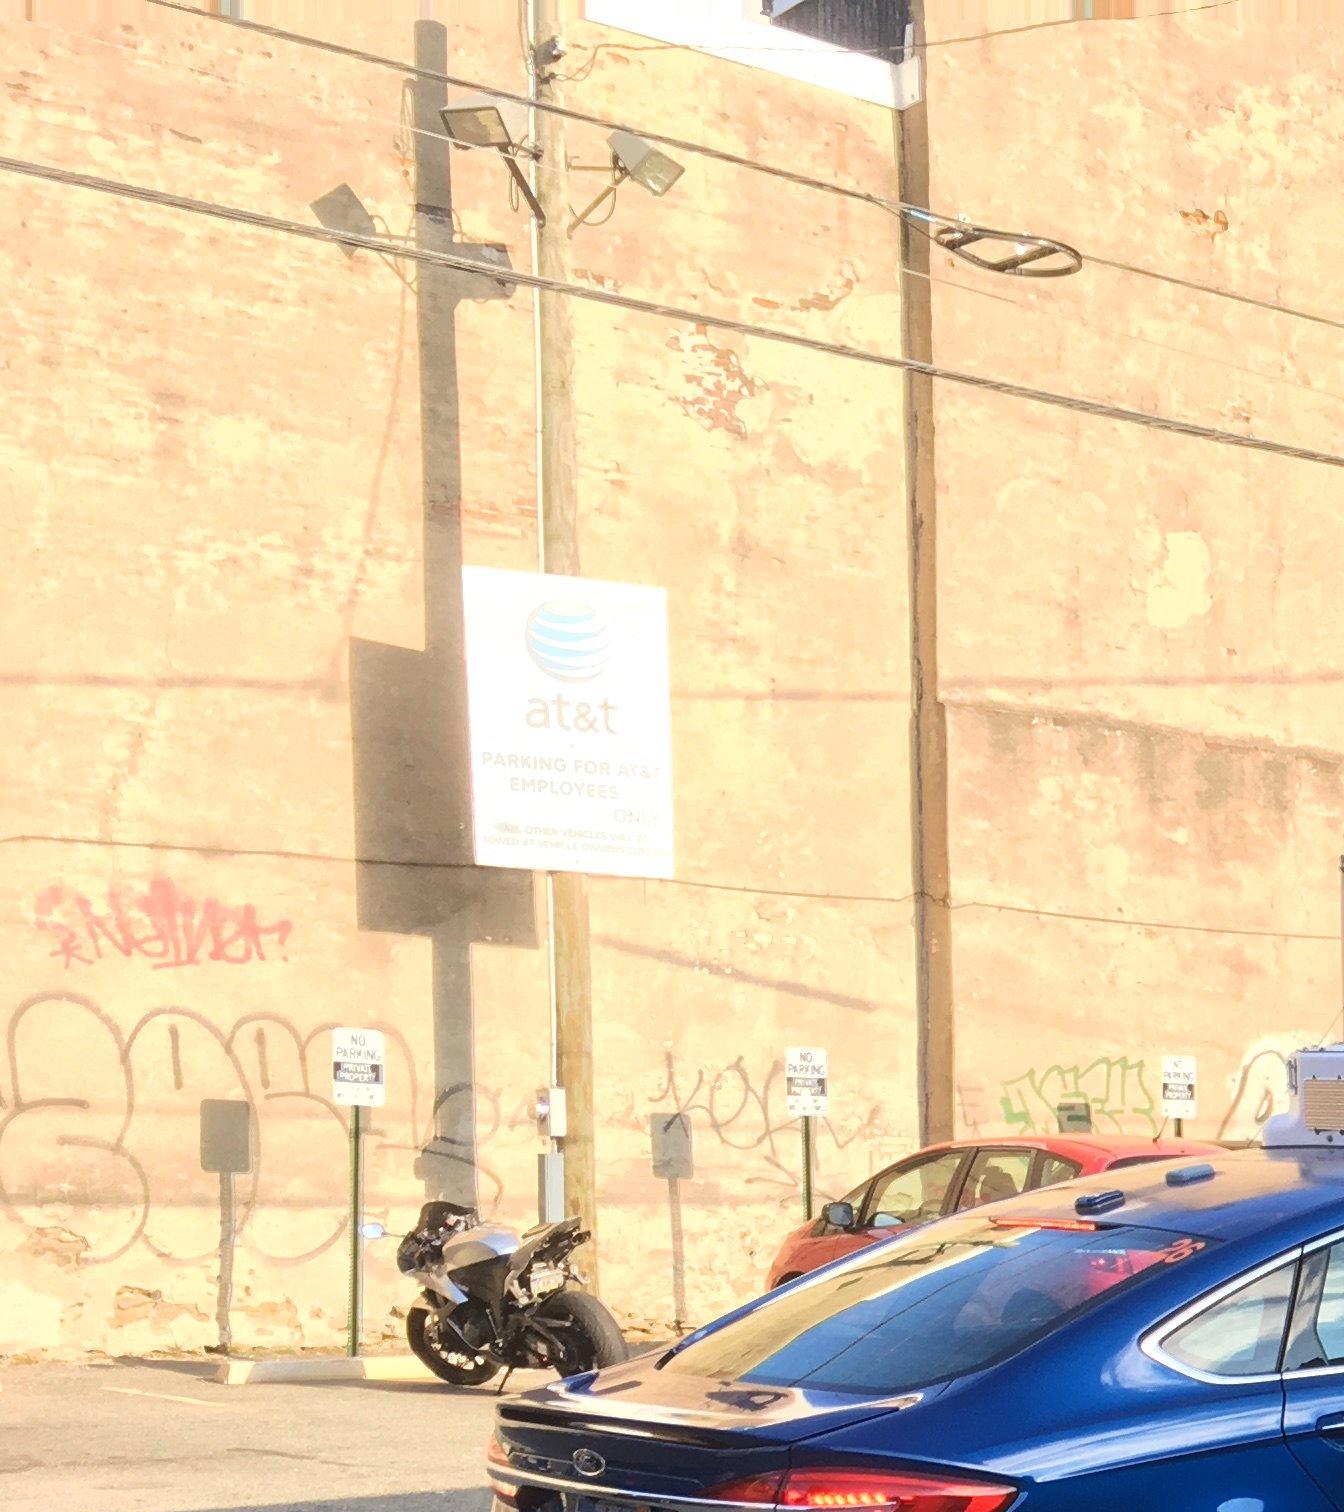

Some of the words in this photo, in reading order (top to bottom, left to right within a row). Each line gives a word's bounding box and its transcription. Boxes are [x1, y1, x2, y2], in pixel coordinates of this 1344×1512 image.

[526, 692, 619, 736] at&t
[482, 751, 567, 773] PARKING
[574, 759, 611, 776] FOR
[510, 777, 620, 800] EMPLOYEES
[351, 1034, 366, 1047] NO
[336, 1046, 381, 1062] PARKING
